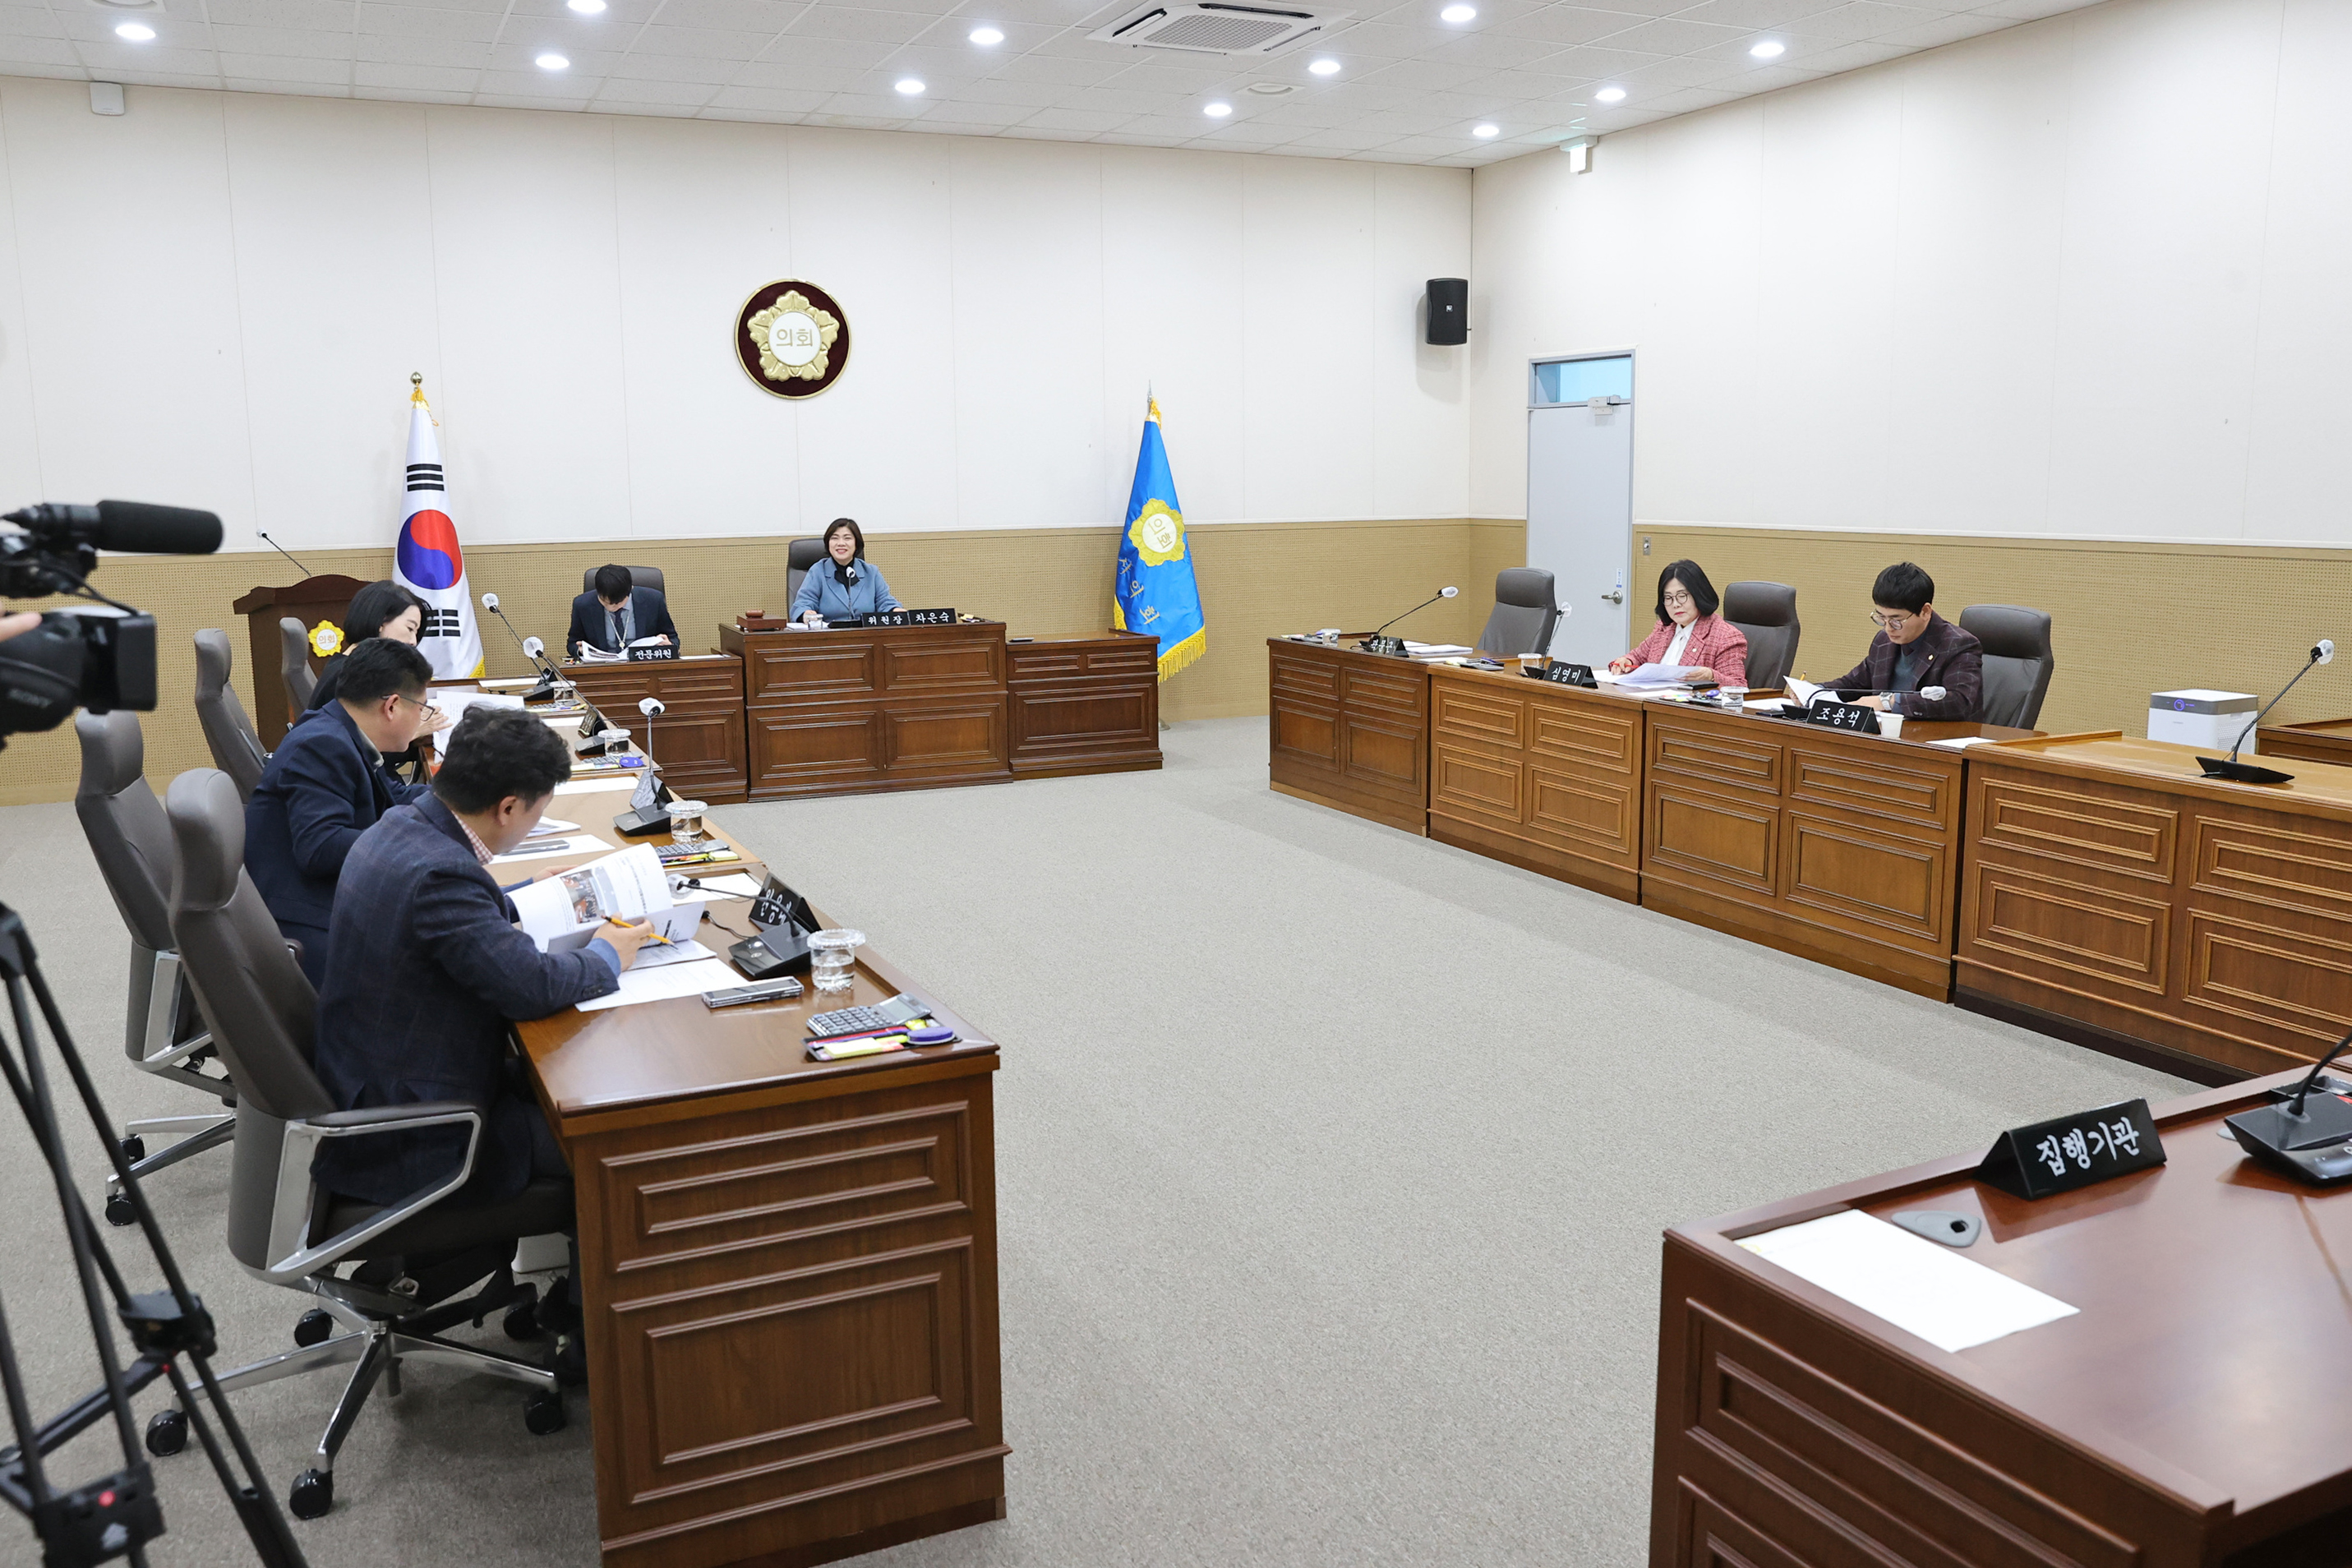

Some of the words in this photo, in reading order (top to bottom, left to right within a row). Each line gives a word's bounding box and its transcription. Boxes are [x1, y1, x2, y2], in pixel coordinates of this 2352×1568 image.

[776, 328, 814, 347] 의회
[1148, 518, 1173, 549] 의회
[867, 615, 903, 626] 위원장
[915, 611, 950, 625] 차은숙
[634, 648, 672, 660] 전문위원
[1552, 666, 1582, 684] 심영미
[1816, 707, 1861, 728] 조용석
[2036, 1116, 2140, 1177] 집행기관
